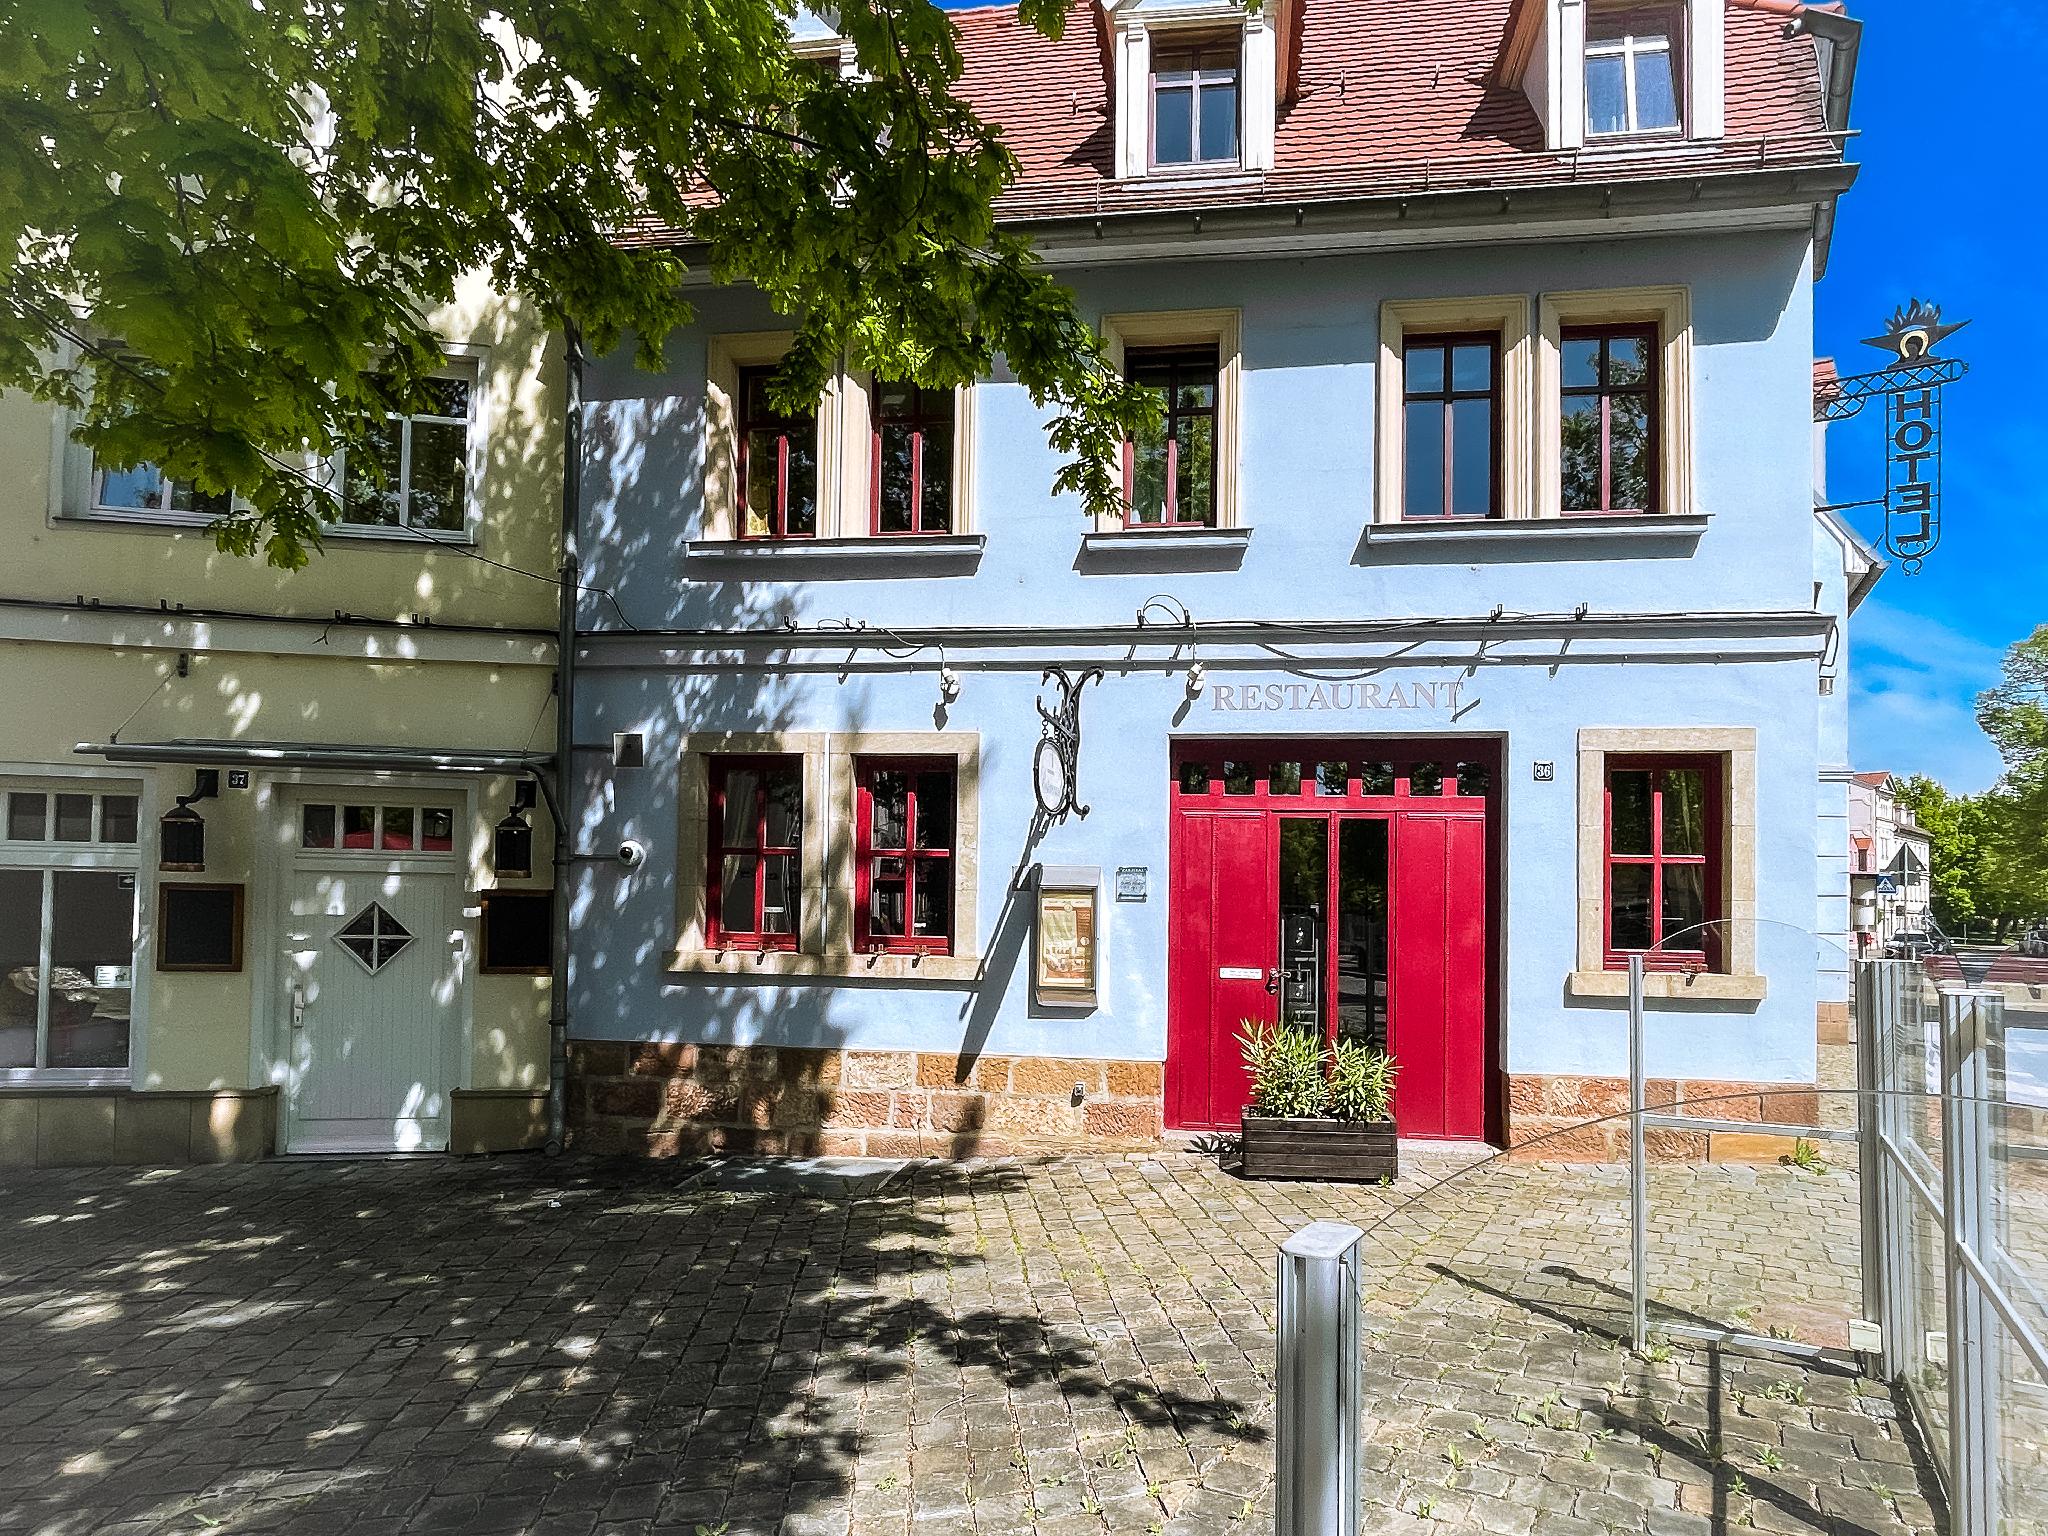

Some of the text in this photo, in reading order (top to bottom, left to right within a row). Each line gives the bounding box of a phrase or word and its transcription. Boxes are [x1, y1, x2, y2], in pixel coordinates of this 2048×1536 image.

[1211, 681, 1465, 711] RESTAURANT
[1537, 765, 1550, 777] 36
[231, 774, 245, 785] 37
